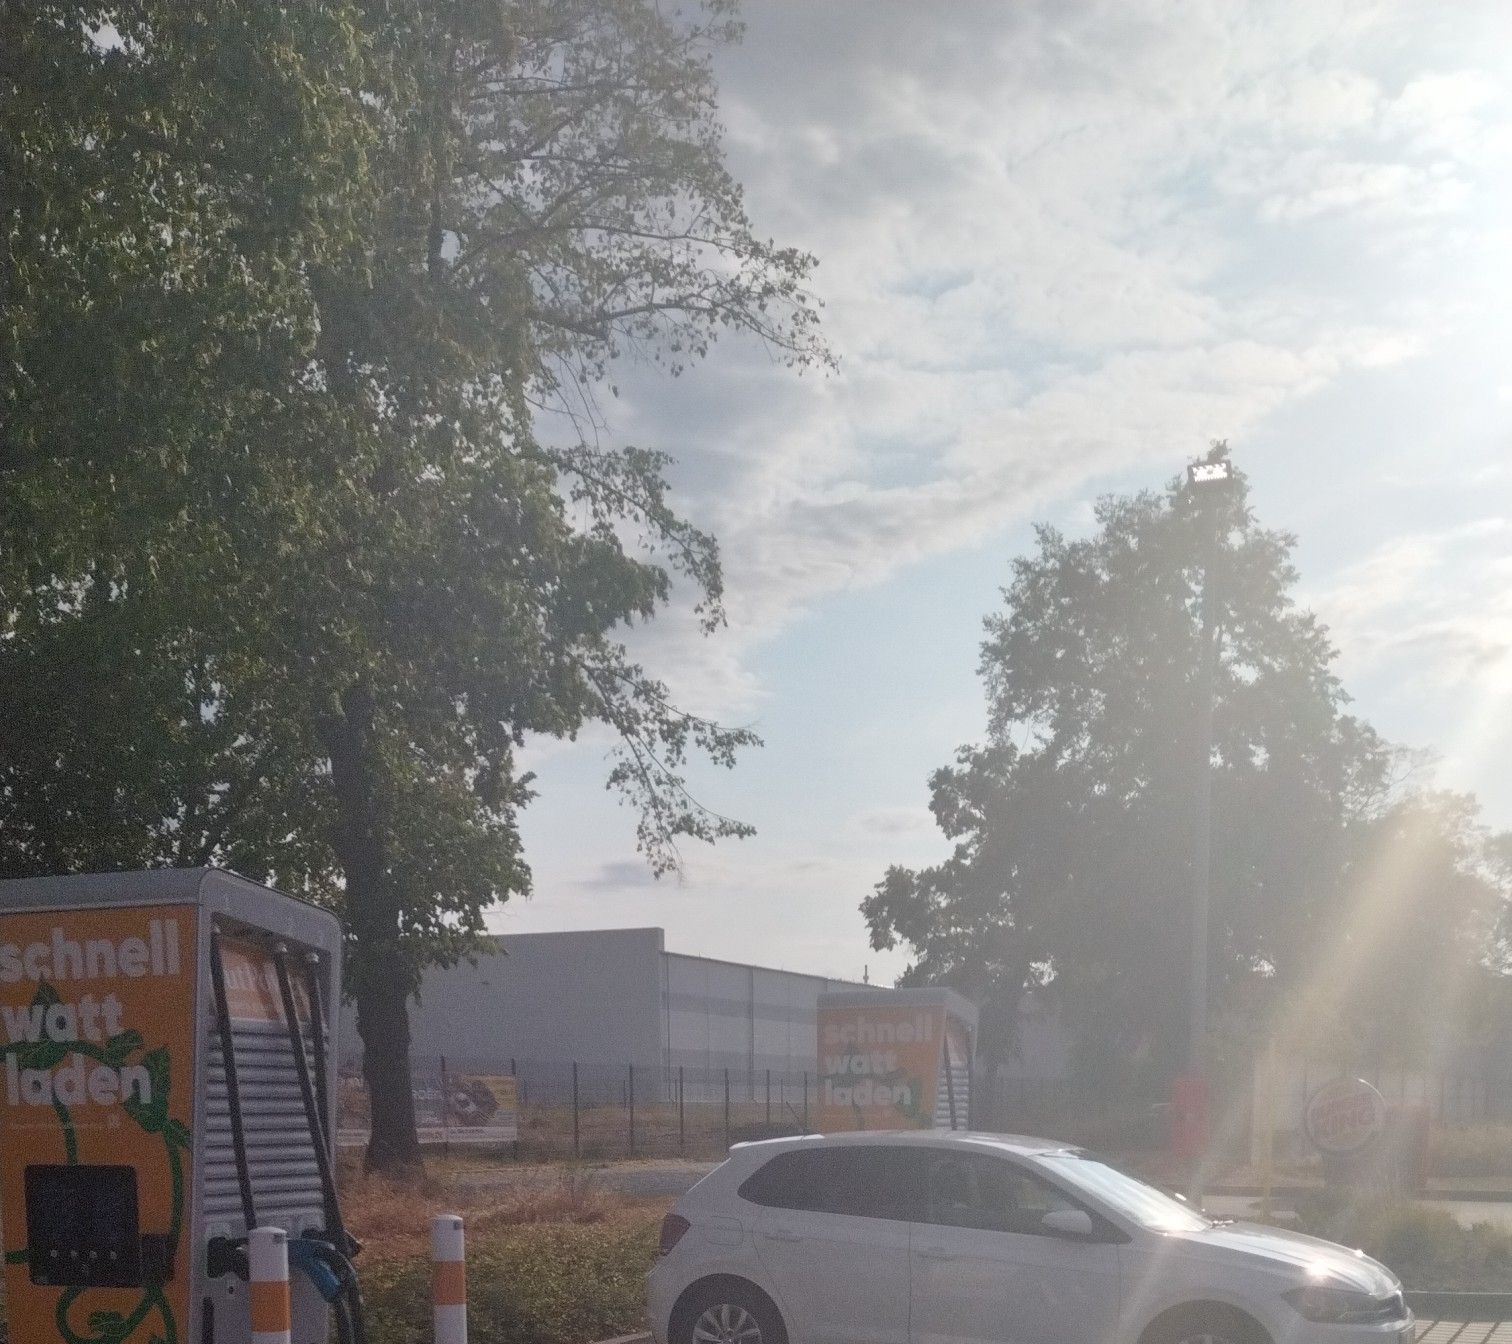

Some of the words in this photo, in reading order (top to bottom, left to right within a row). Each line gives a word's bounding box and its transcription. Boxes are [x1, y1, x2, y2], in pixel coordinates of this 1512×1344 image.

[0, 918, 180, 982] schnell
[1, 992, 125, 1044] watt
[824, 1013, 933, 1045] schnell
[5, 1051, 152, 1106] laden
[825, 1050, 898, 1075] watt
[825, 1078, 911, 1106] laden
